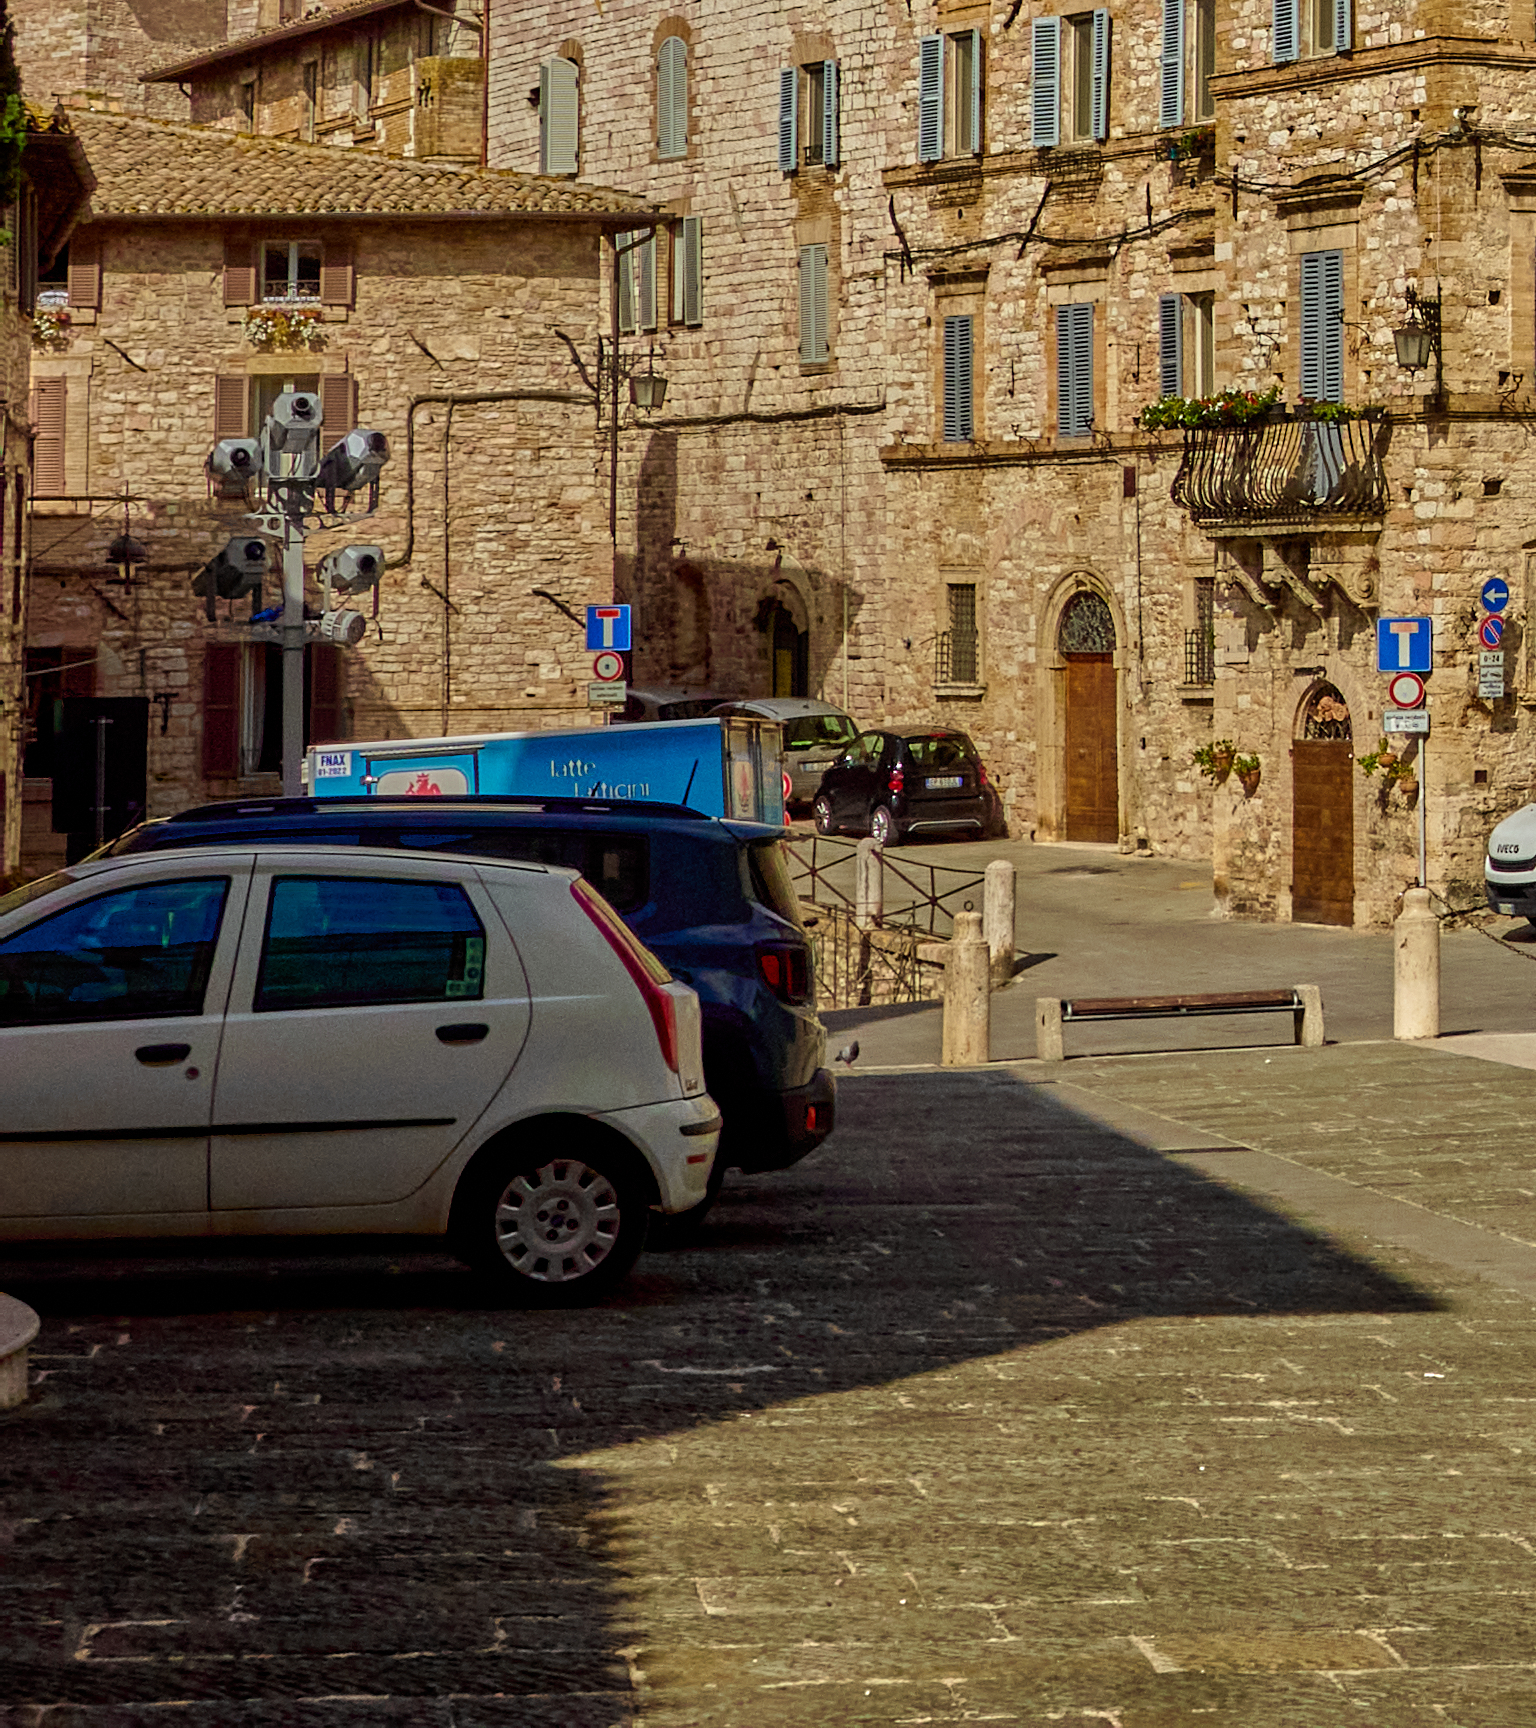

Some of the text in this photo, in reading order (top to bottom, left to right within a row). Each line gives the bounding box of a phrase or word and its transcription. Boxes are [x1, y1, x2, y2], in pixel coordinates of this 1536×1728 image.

[320, 754, 346, 767] FNAX
[318, 766, 348, 776] 01-2022
[550, 759, 597, 778] latte
[1496, 843, 1520, 854] IVECO
